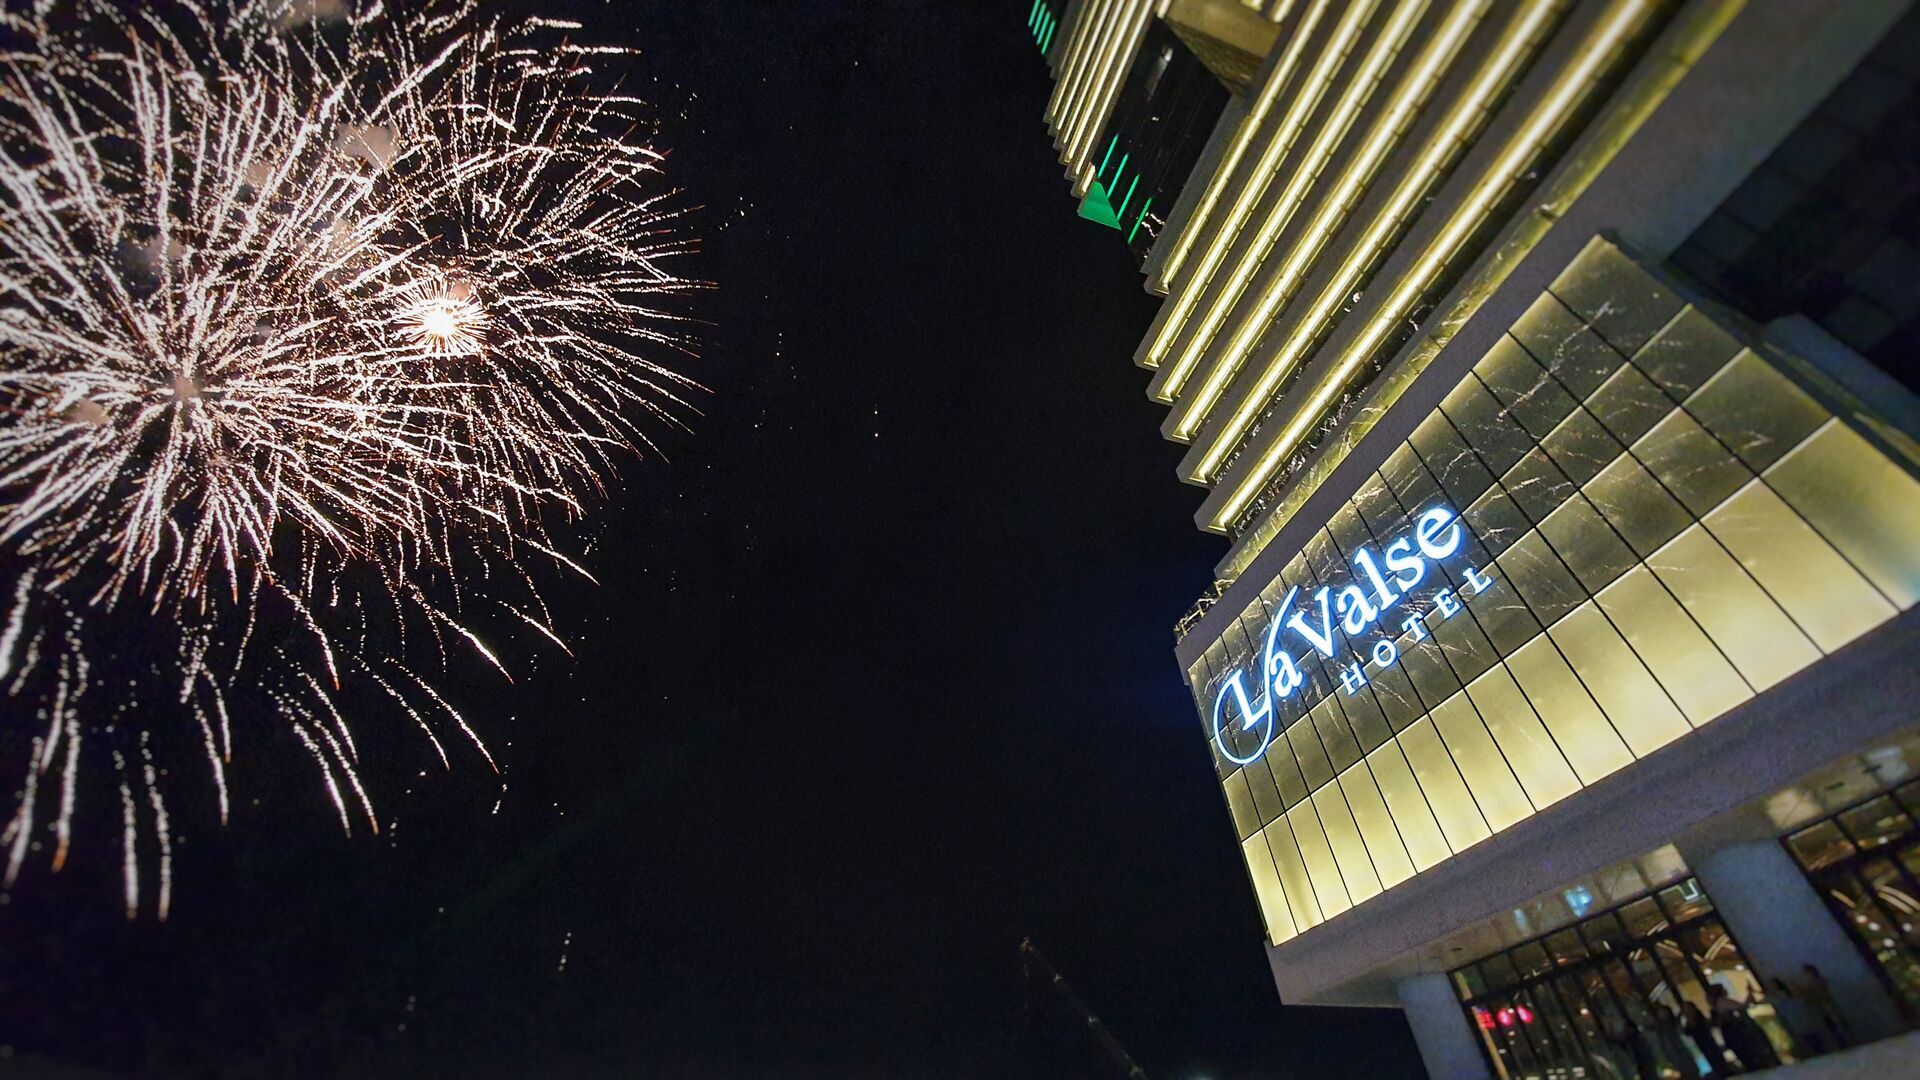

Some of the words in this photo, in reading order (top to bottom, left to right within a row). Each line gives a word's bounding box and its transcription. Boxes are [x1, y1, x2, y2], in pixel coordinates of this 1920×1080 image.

[1213, 585, 1303, 764] La
[1287, 507, 1461, 658] Valse
[1340, 567, 1493, 695] HOTEL
